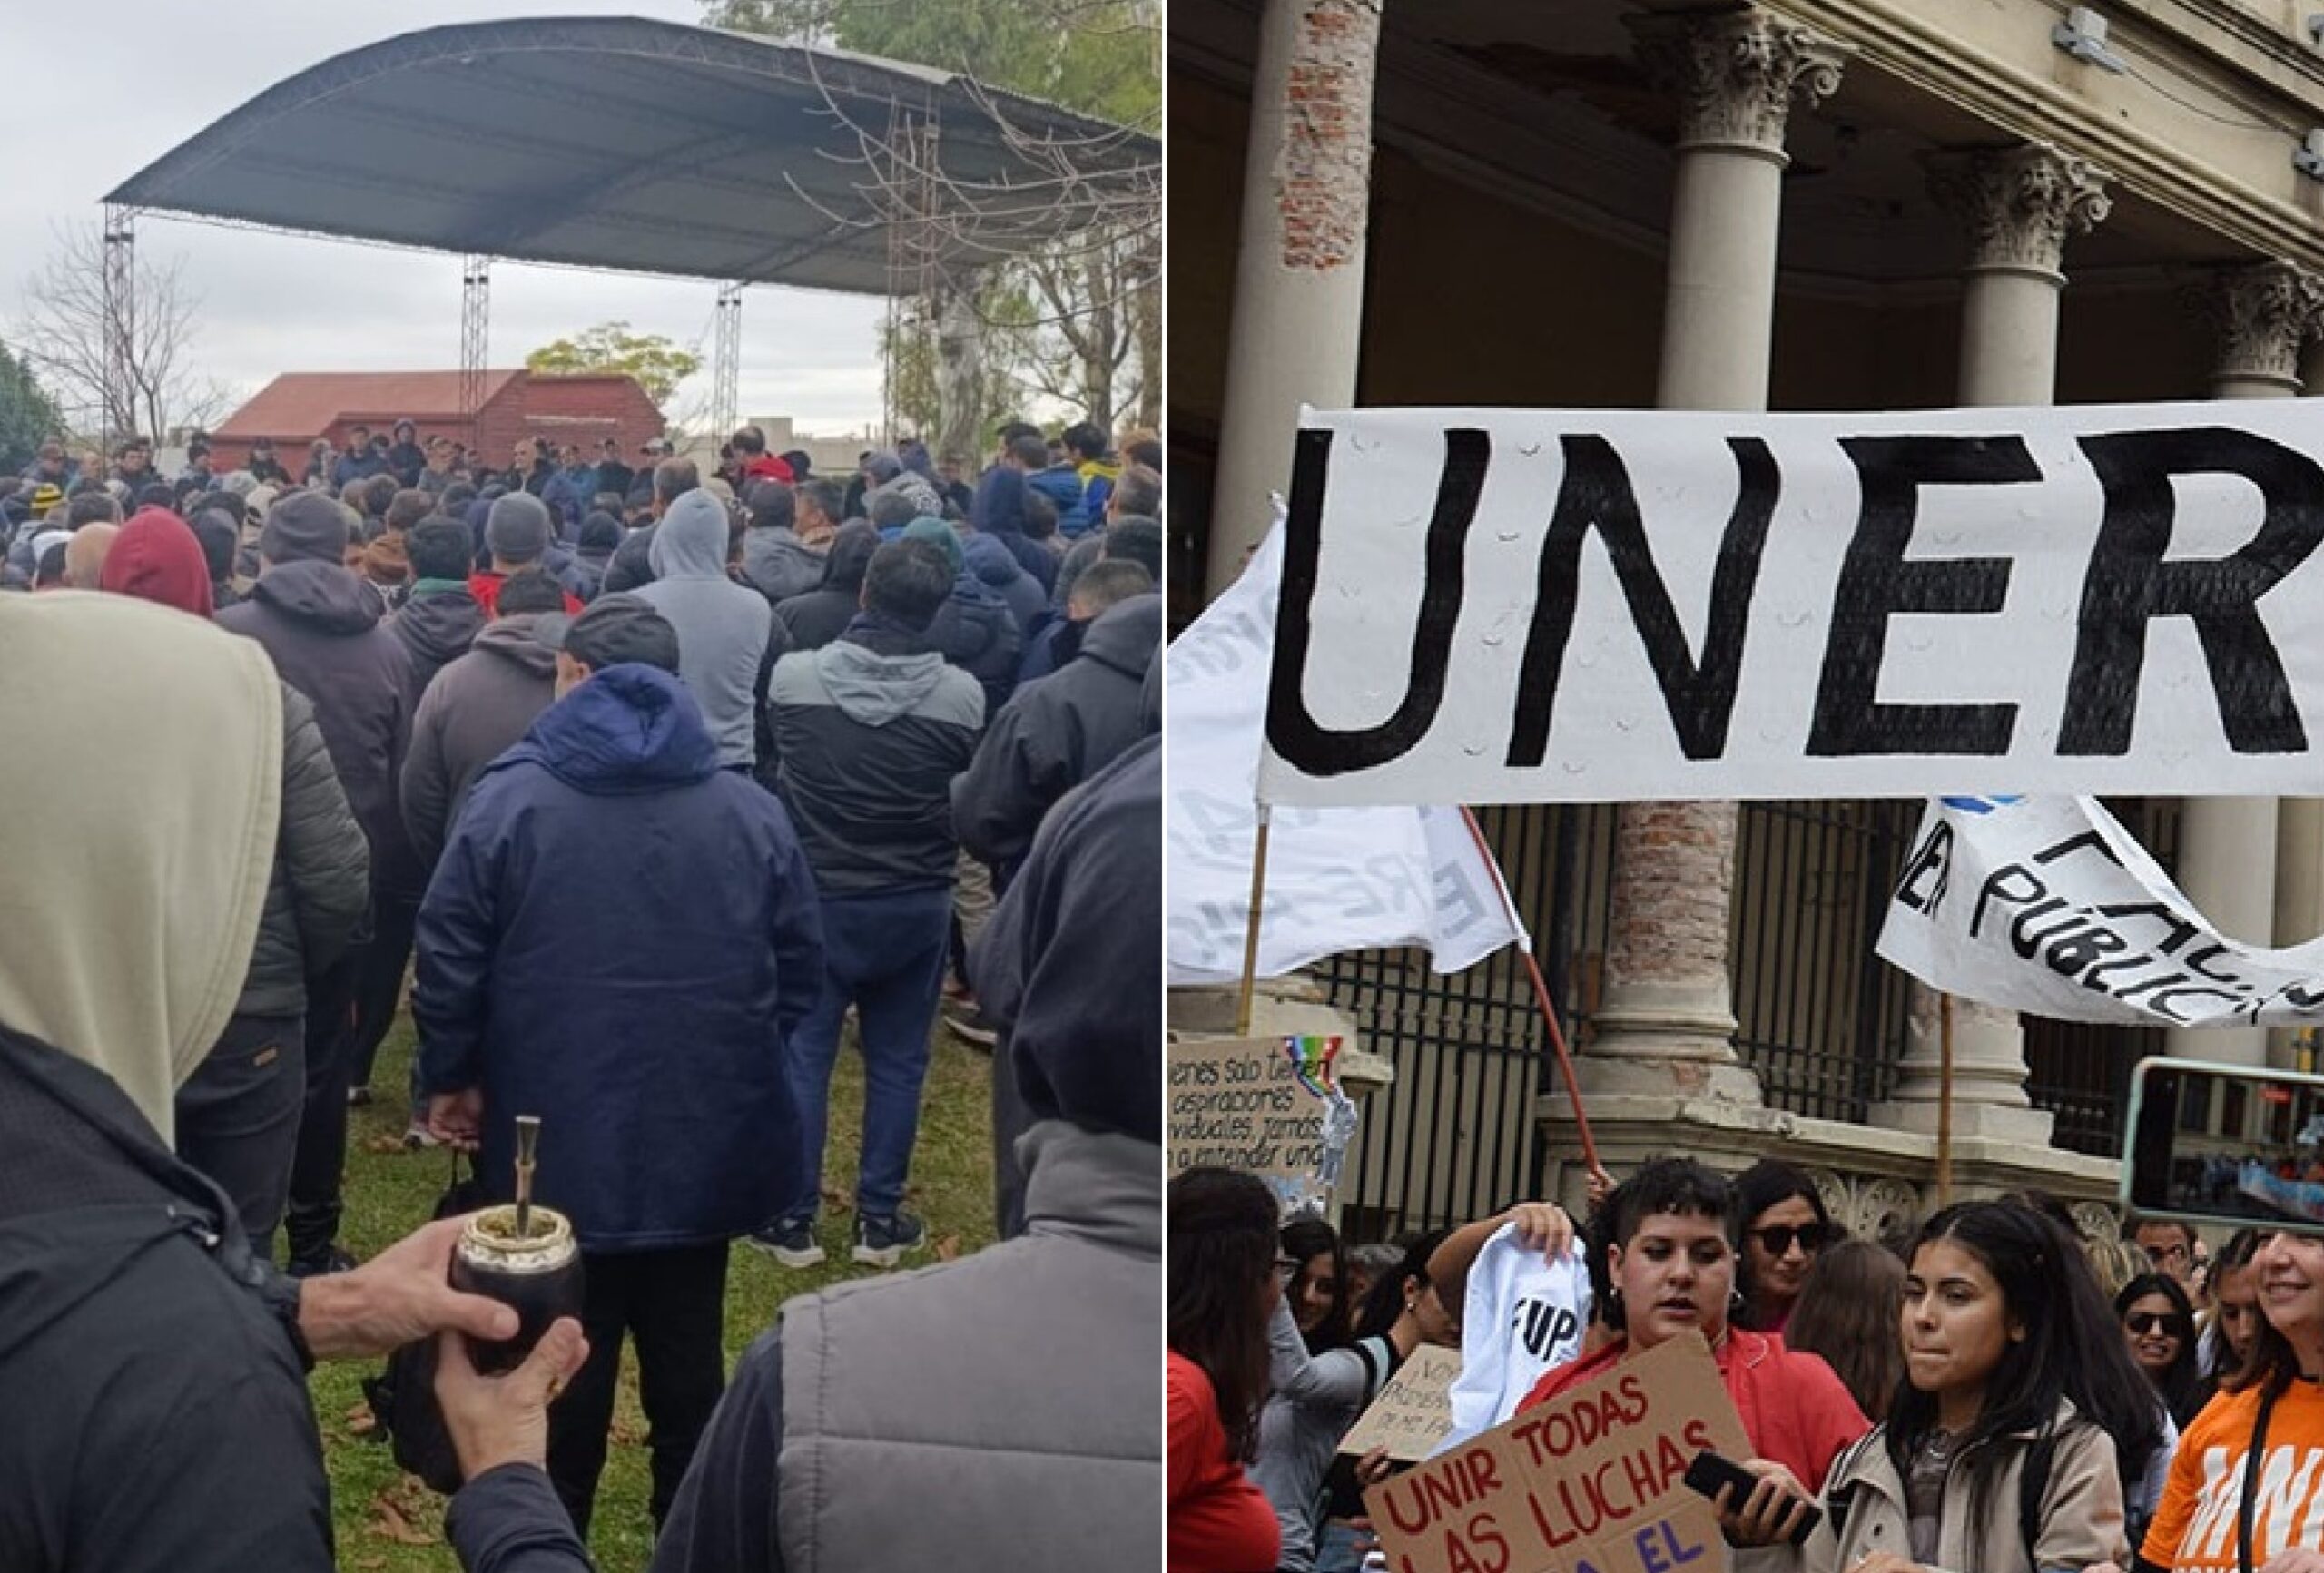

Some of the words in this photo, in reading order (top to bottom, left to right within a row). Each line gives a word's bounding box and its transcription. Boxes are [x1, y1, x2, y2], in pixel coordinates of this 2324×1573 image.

[1265, 425, 2324, 776] UNER
[1173, 1086, 1295, 1116] aspiraciones
[1383, 1449, 1502, 1536] UNIR
[1512, 1375, 1649, 1469] TODAS
[1527, 1420, 1715, 1548] LUCHAS
[1635, 1519, 1705, 1573] EL
